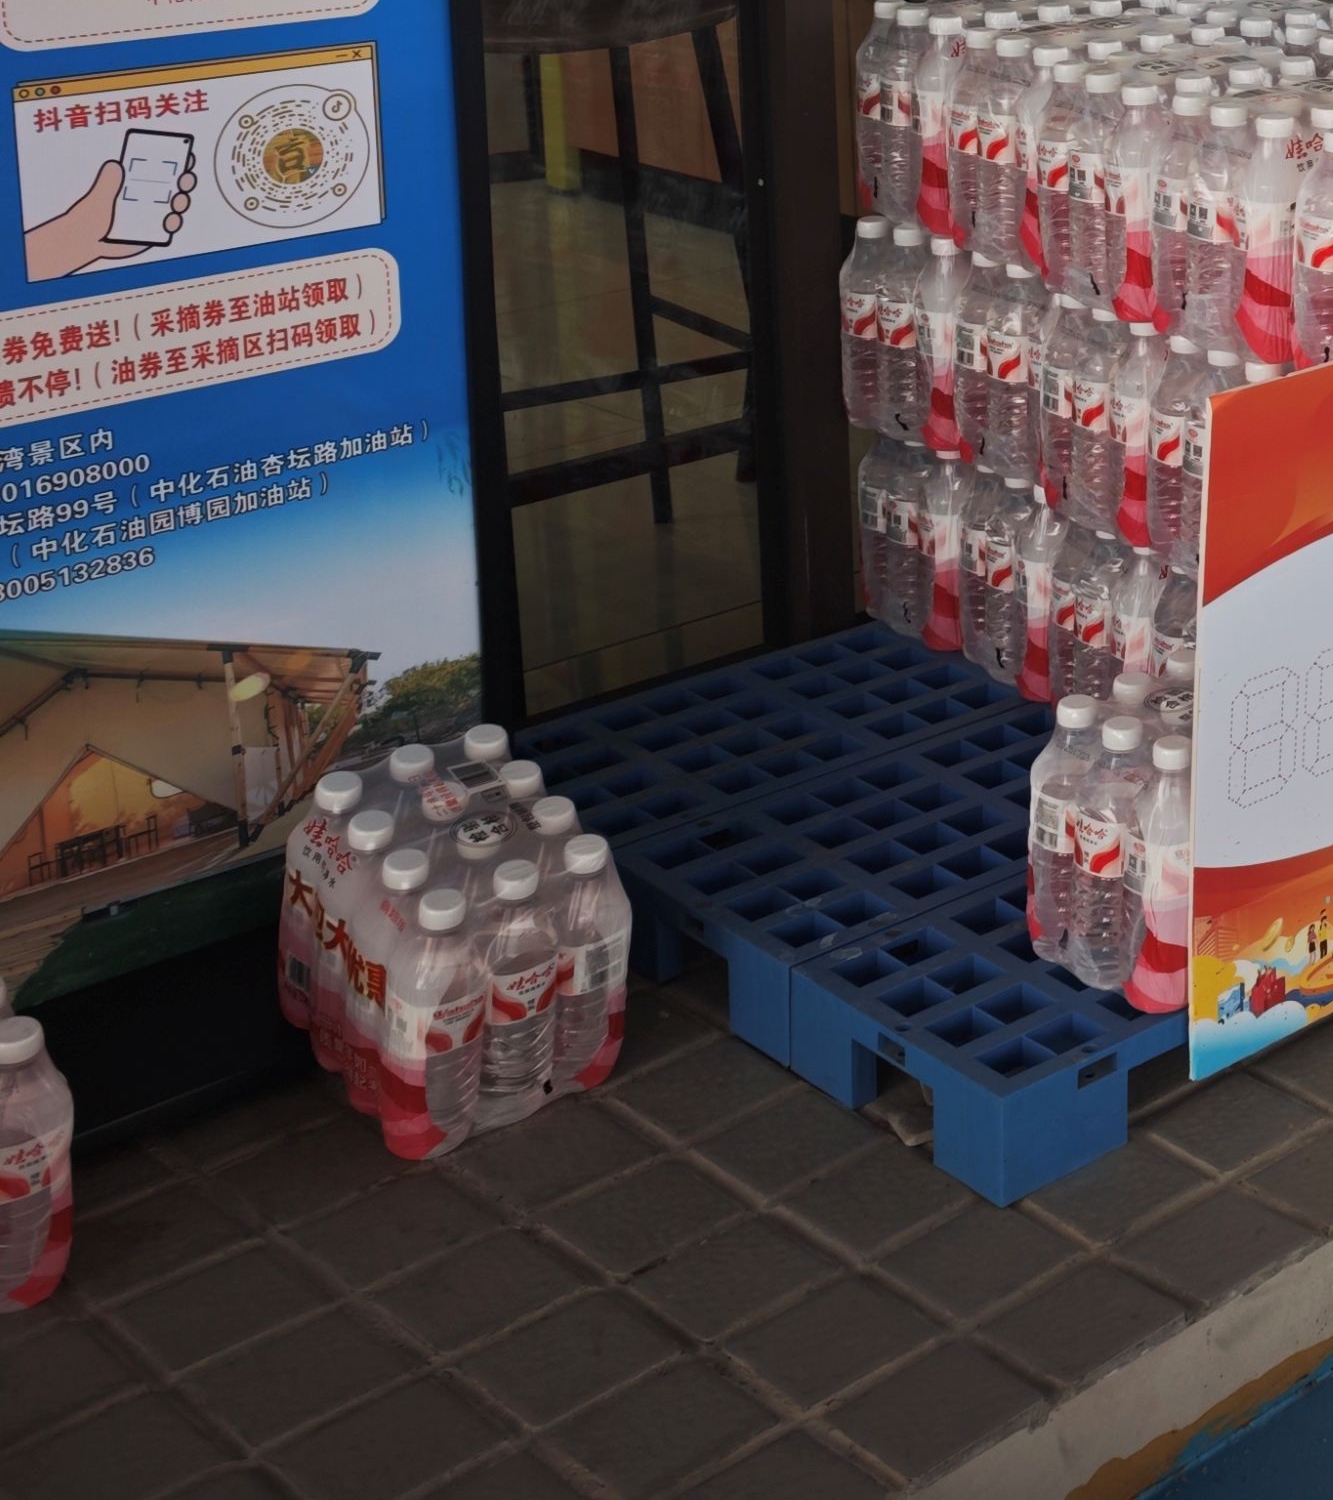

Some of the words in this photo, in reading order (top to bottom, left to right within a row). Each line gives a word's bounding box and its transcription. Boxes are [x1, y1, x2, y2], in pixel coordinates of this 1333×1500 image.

[34, 90, 210, 133] 抖音扫码关注
[10, 472, 329, 568] (中化石油园博园加油站)
[303, 818, 354, 876] 娃哈哈
